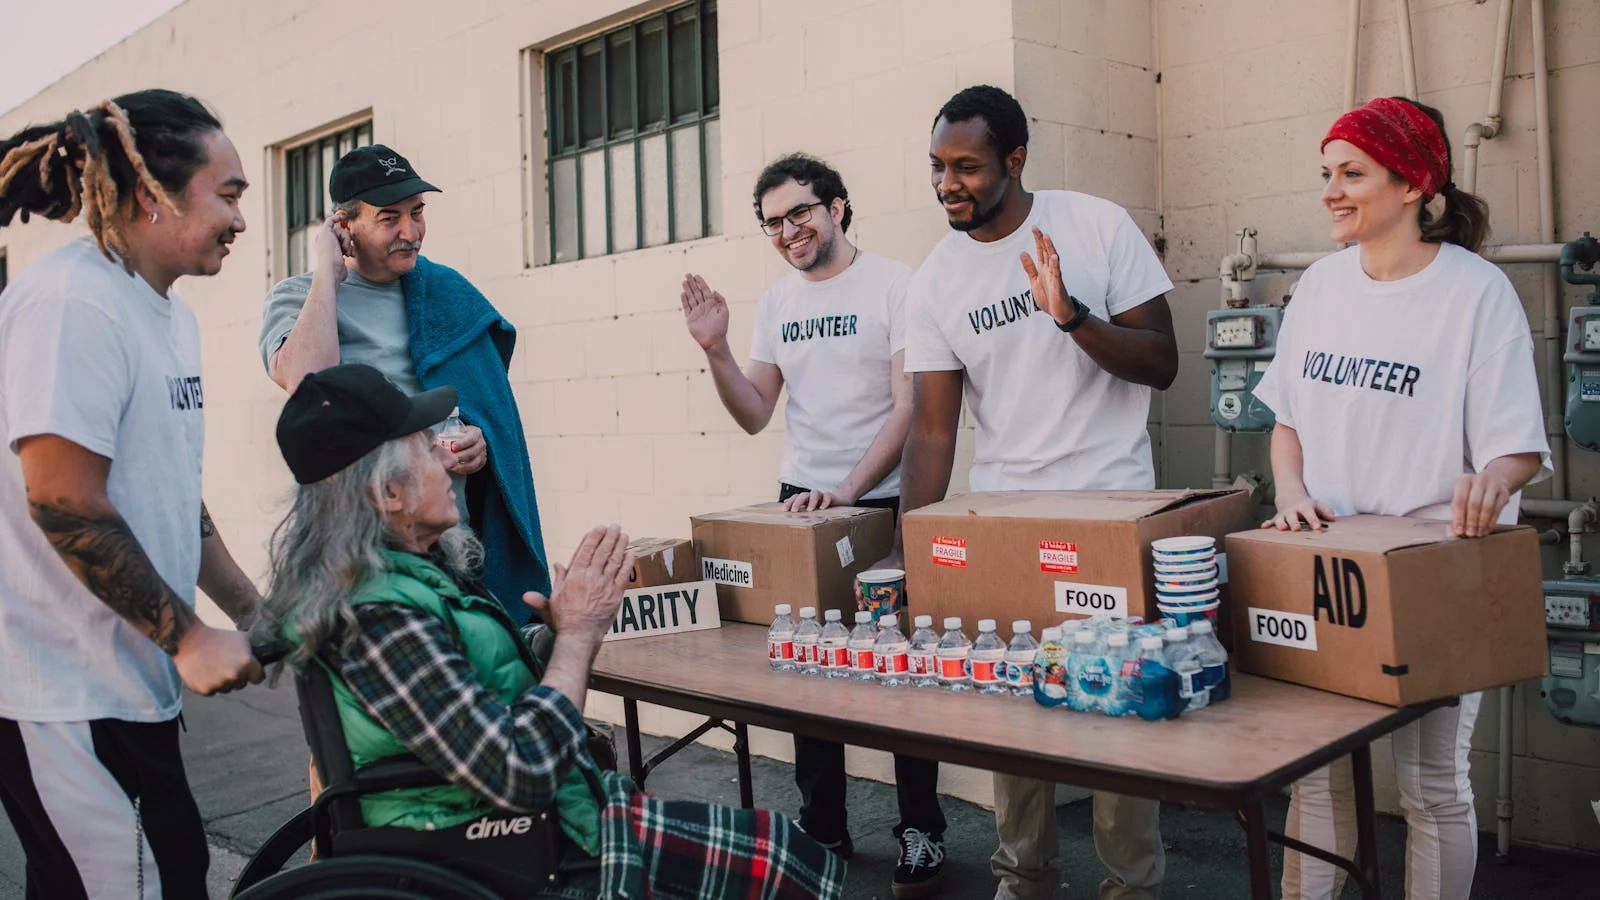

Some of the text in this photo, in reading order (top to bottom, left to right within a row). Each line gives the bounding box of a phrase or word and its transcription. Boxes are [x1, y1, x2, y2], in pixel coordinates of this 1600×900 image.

[782, 314, 858, 343] VOLUNTEER
[1302, 350, 1421, 398] VOLUNTEER
[935, 546, 964, 559] FRAGILE
[1043, 551, 1075, 564] FRAGILE
[704, 560, 749, 584] Medicine
[1066, 589, 1116, 610] FOOD
[1313, 554, 1368, 629] AID
[1256, 614, 1308, 641] FOOD
[465, 816, 533, 841] drive
